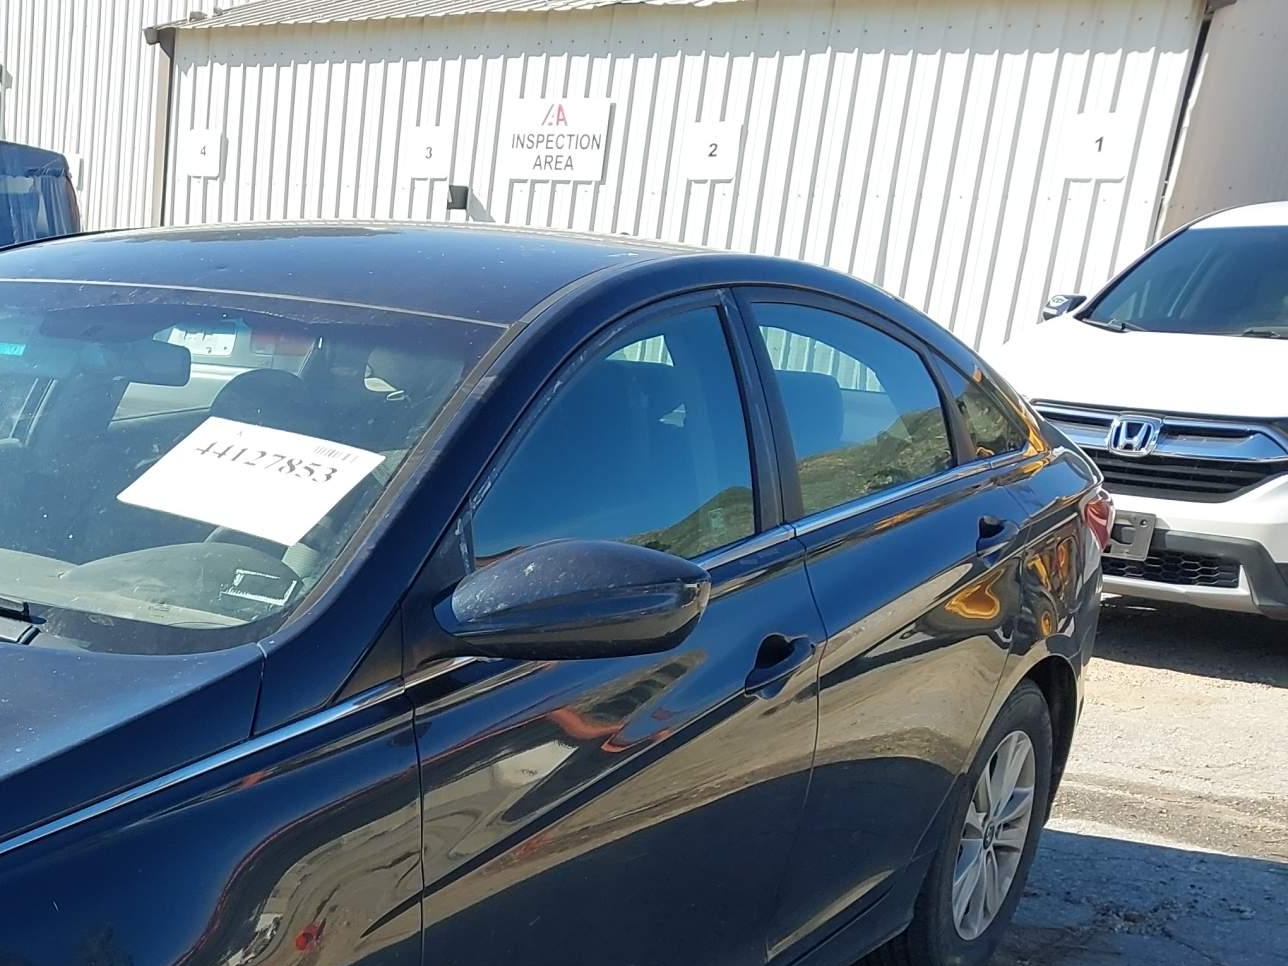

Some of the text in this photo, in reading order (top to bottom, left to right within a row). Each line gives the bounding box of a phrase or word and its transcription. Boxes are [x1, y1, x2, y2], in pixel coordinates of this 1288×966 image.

[511, 133, 602, 151] INSPECTION
[708, 142, 718, 157] 2
[1094, 136, 1105, 153] 1
[199, 145, 207, 157] 4
[425, 146, 433, 160] 3
[532, 154, 574, 171] AREA
[195, 441, 339, 483] 44127853
